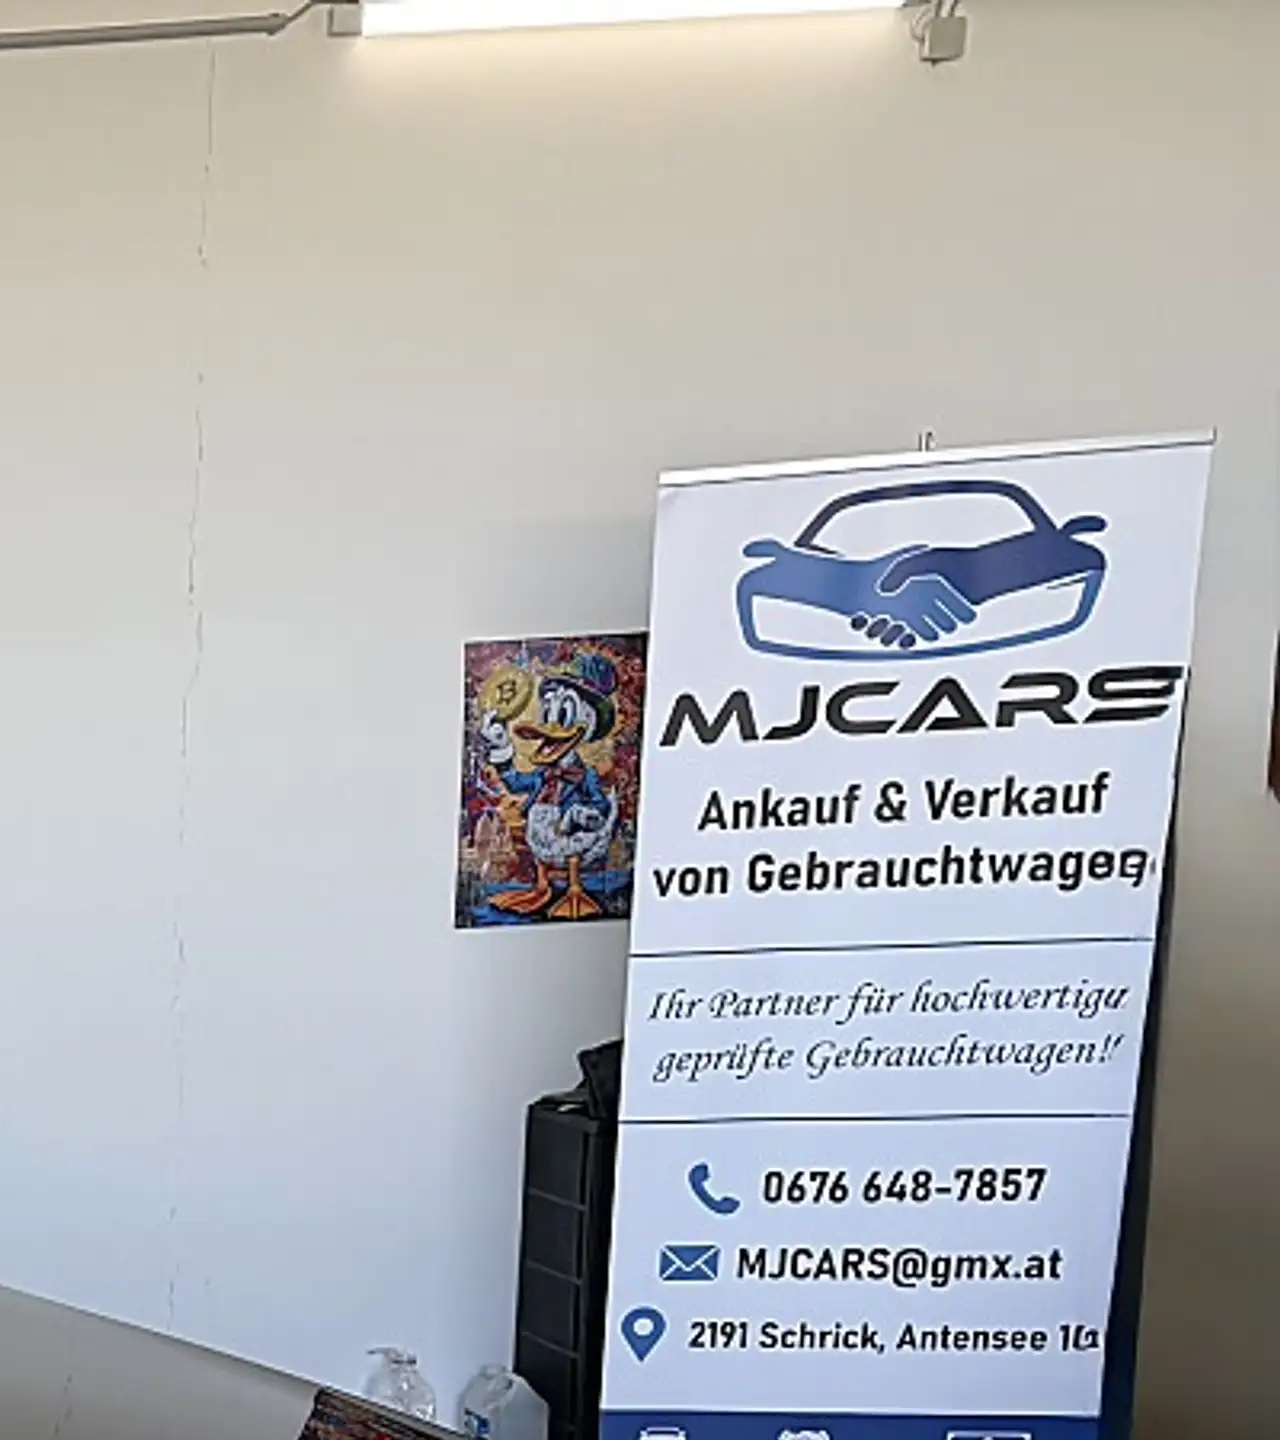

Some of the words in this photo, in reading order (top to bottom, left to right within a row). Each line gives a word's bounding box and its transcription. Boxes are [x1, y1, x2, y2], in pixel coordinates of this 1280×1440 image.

[660, 665, 1186, 747] MJCARS
[698, 784, 861, 830] Ankauf
[875, 782, 906, 822] &
[925, 772, 1109, 819] Verkauf
[653, 867, 728, 896] von
[649, 988, 702, 1018] Ihr
[710, 988, 838, 1018] Partner
[837, 982, 904, 1025] für
[653, 1038, 794, 1082] geprüfte
[807, 1034, 1124, 1079] Gebrauchtwagen!!
[764, 1172, 848, 1203] 0676
[863, 1168, 1046, 1203] 648-7857
[738, 1248, 1062, 1287] MJCARS@gmx.at
[689, 1322, 747, 1348] 2191
[759, 1322, 884, 1353] Schrick,
[896, 1324, 1047, 1350] Antensee
